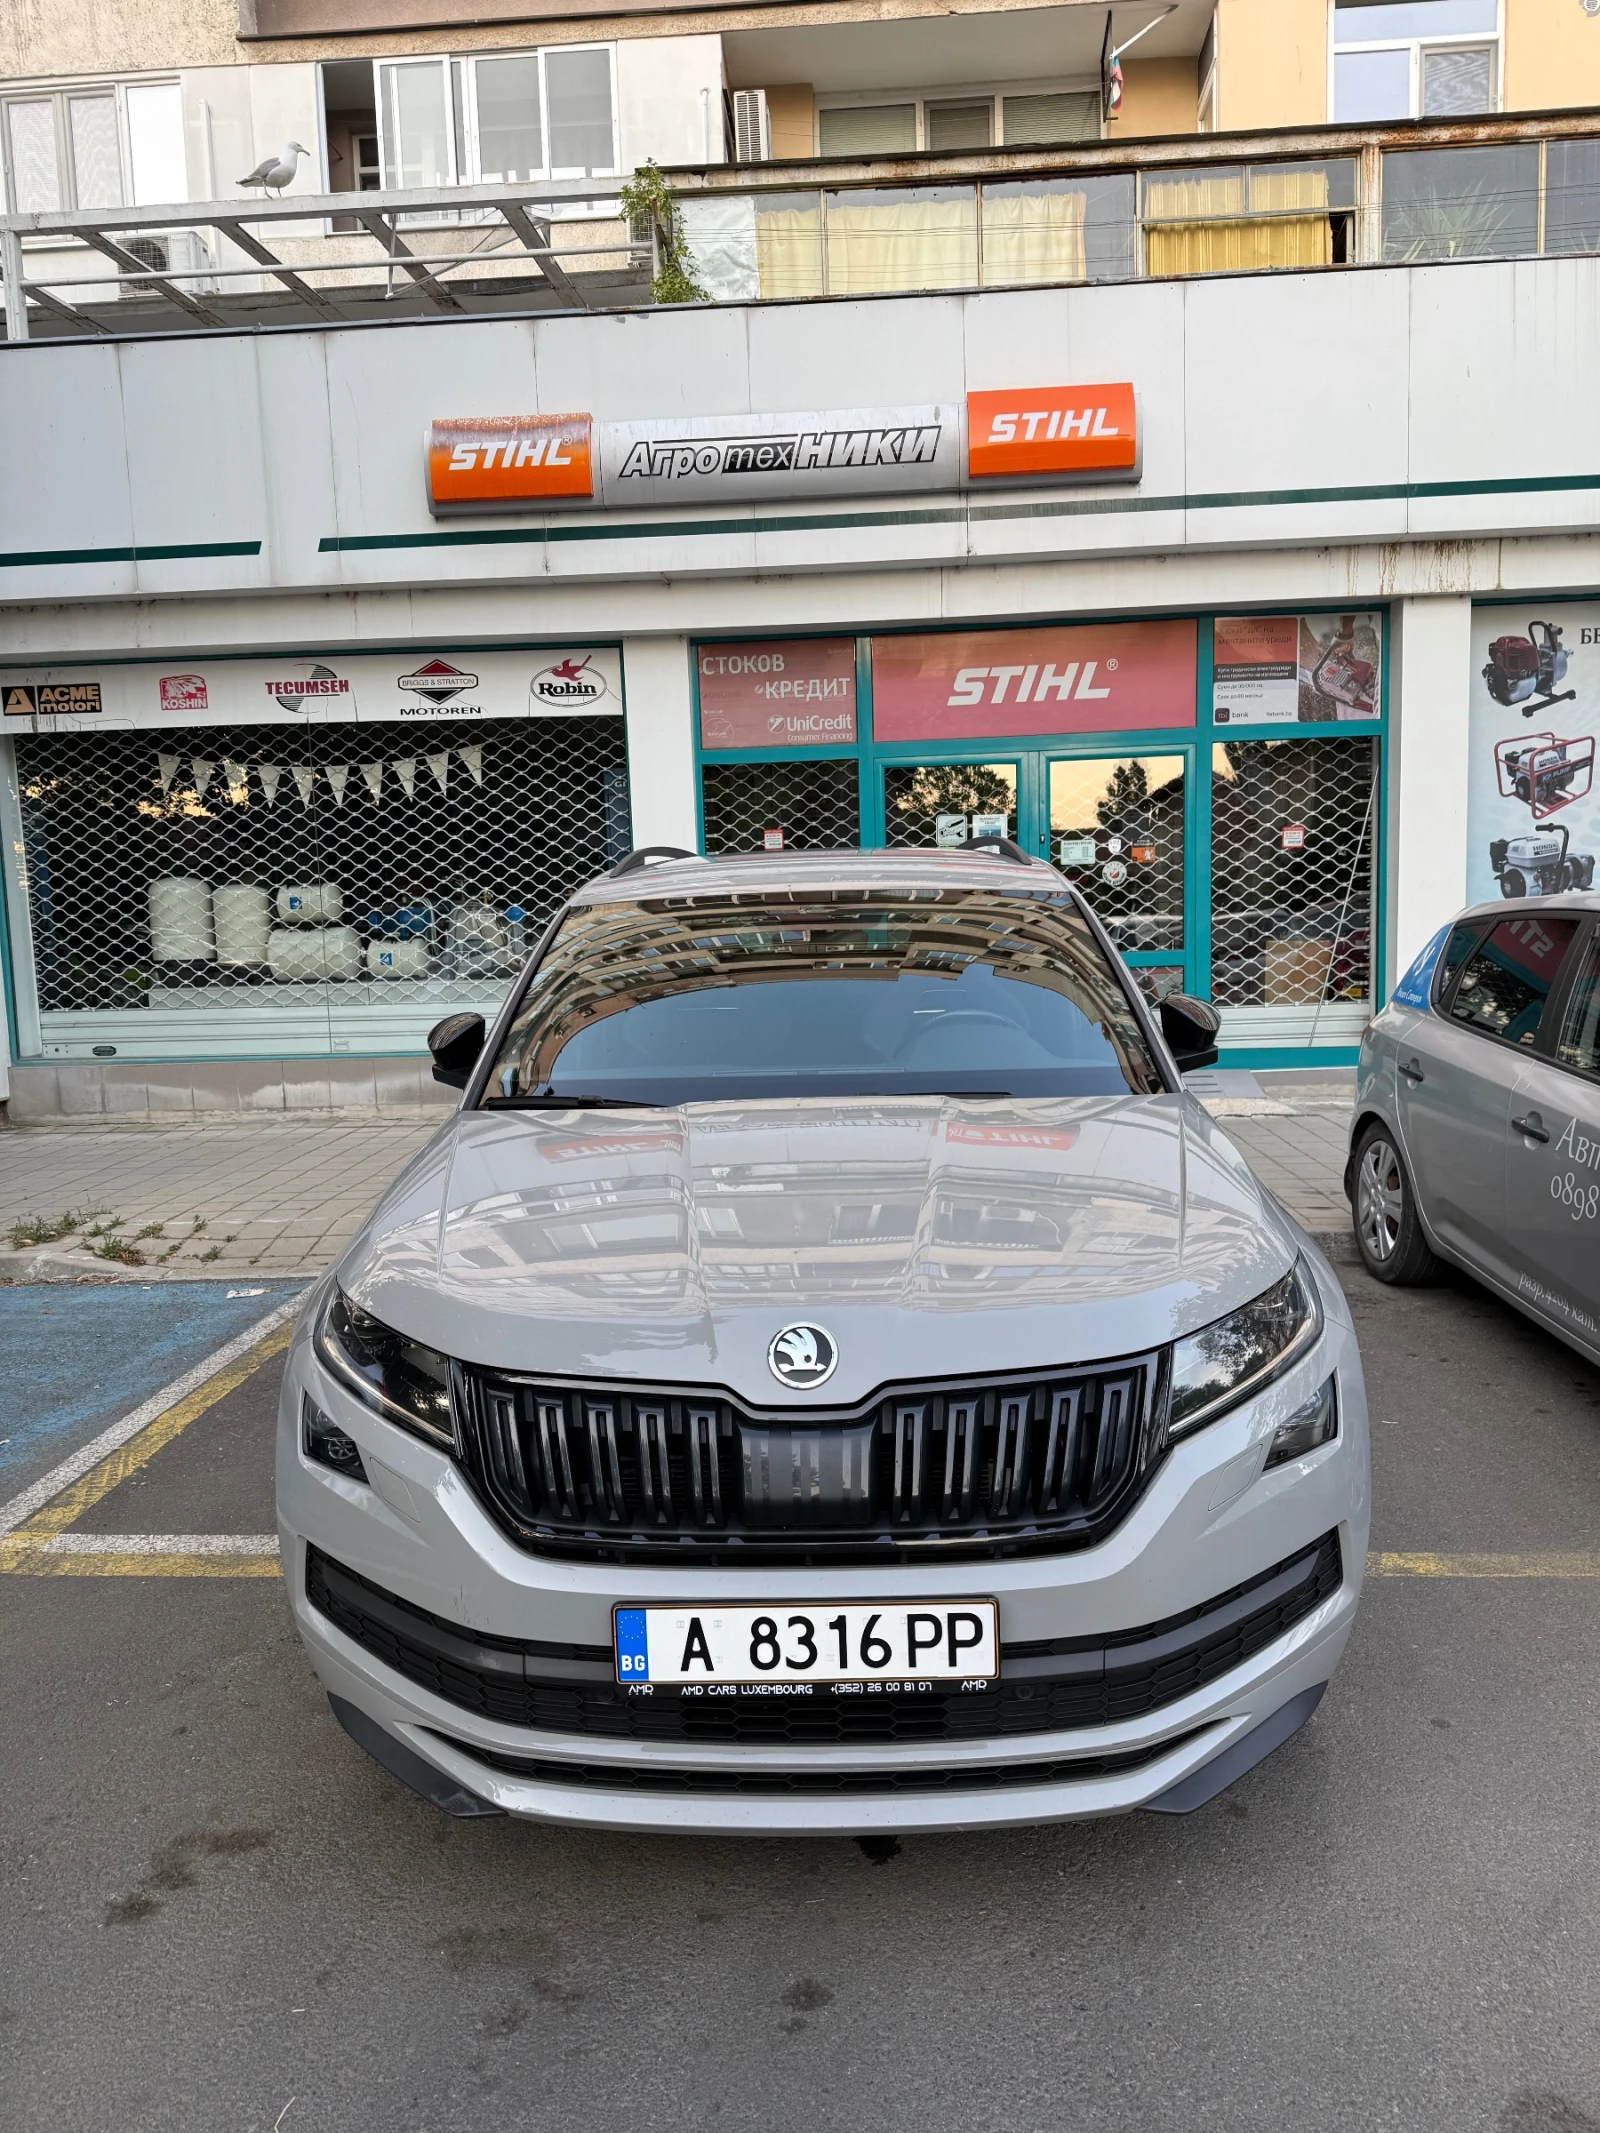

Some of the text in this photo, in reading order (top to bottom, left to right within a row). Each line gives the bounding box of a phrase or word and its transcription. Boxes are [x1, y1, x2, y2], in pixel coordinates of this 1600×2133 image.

[987, 408, 1119, 443] STIHL
[702, 654, 785, 676] СТОКОВ
[265, 679, 349, 696] TECUMSEH
[401, 679, 430, 687] BRIGGS
[437, 677, 475, 686] STRATTON
[538, 682, 597, 696] Robin
[765, 677, 851, 702] КРЕДИТ
[946, 661, 1111, 707] STIHL
[40, 684, 100, 701] ACME
[39, 701, 101, 713] motori
[162, 698, 207, 710] KOSHIN
[400, 706, 481, 716] MOTOREN
[787, 714, 852, 732] UniCredit
[787, 732, 853, 742] Consumer Financing
[1532, 843, 1558, 851] HONDA
[680, 1617, 715, 1672] A
[621, 1655, 646, 1672] BG
[681, 1681, 932, 1696] AMD CARS LUXEMBOURG +(352) 26 00 81 07
